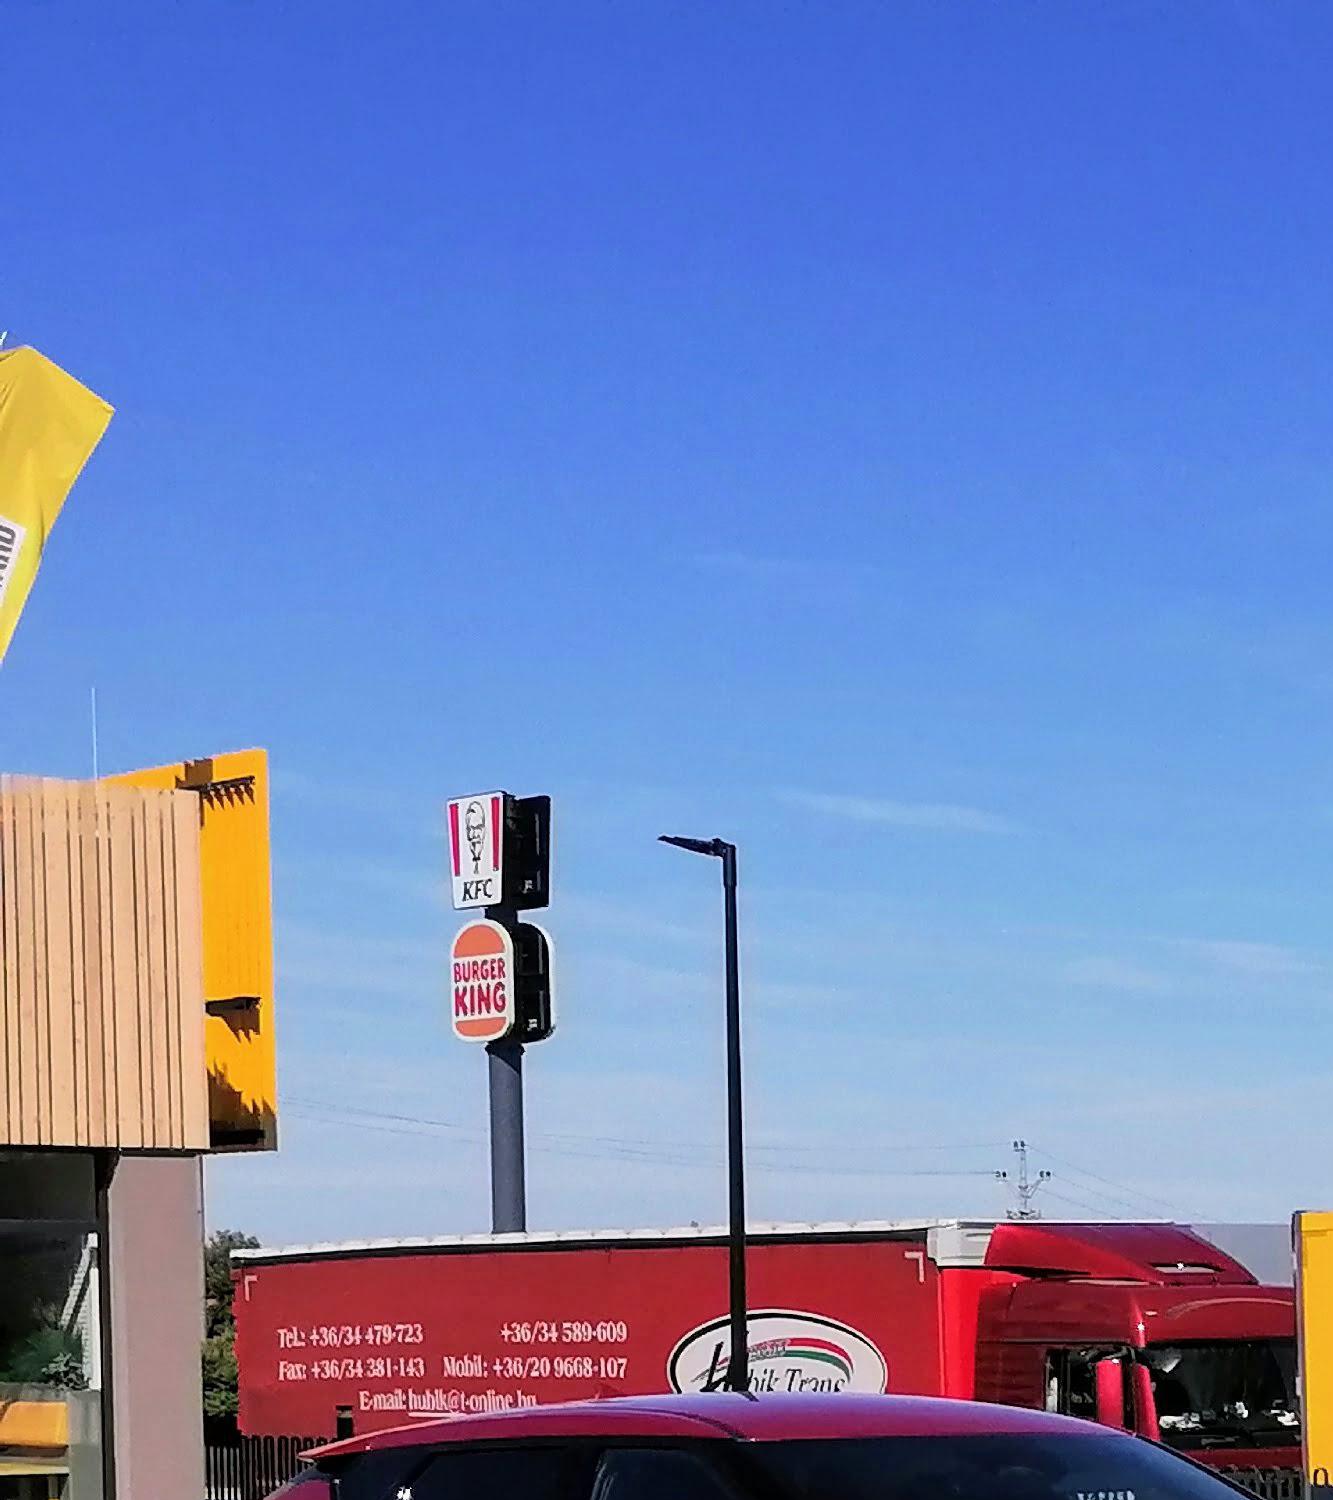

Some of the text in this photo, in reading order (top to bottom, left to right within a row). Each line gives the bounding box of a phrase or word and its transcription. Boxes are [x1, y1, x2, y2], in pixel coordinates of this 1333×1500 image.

[463, 879, 493, 901] KFC
[453, 958, 505, 983] BURGER
[454, 982, 506, 1017] KING
[561, 1320, 628, 1343] 589-609
[443, 1354, 488, 1378] Mobil:
